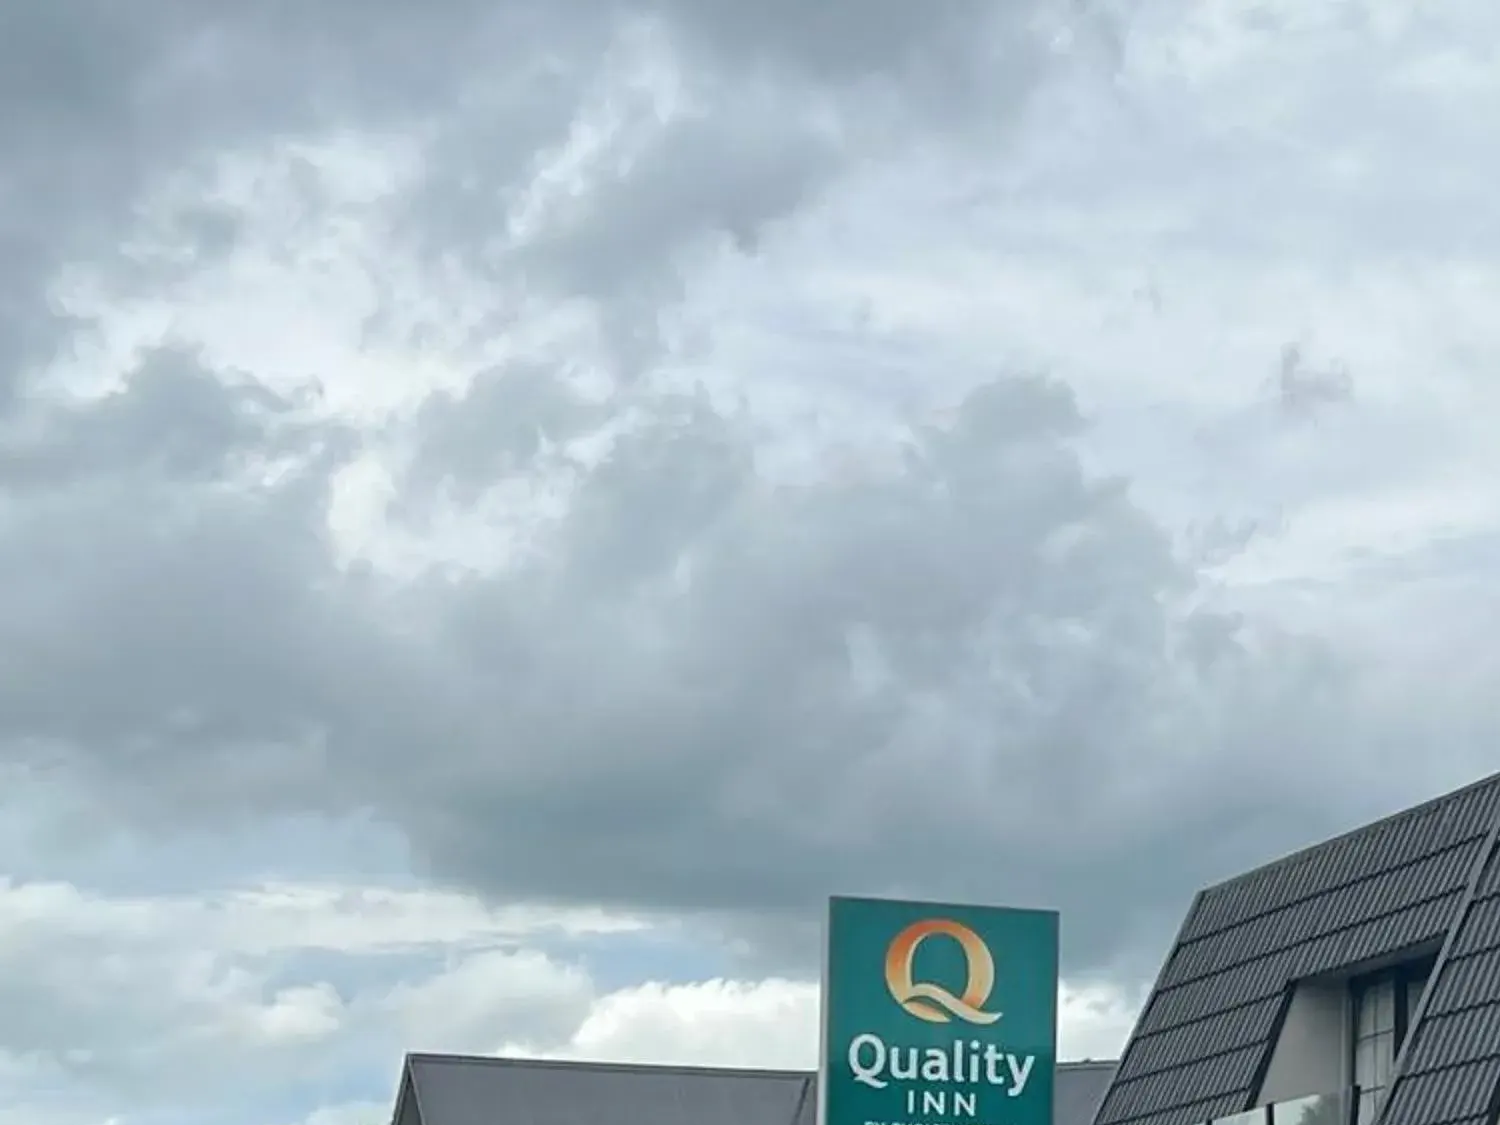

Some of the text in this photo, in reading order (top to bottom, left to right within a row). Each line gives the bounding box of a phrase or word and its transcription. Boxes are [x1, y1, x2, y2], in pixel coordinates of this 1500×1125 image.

[884, 918, 1003, 1025] Q
[848, 1033, 1035, 1097] Quality
[907, 1090, 976, 1117] INN
